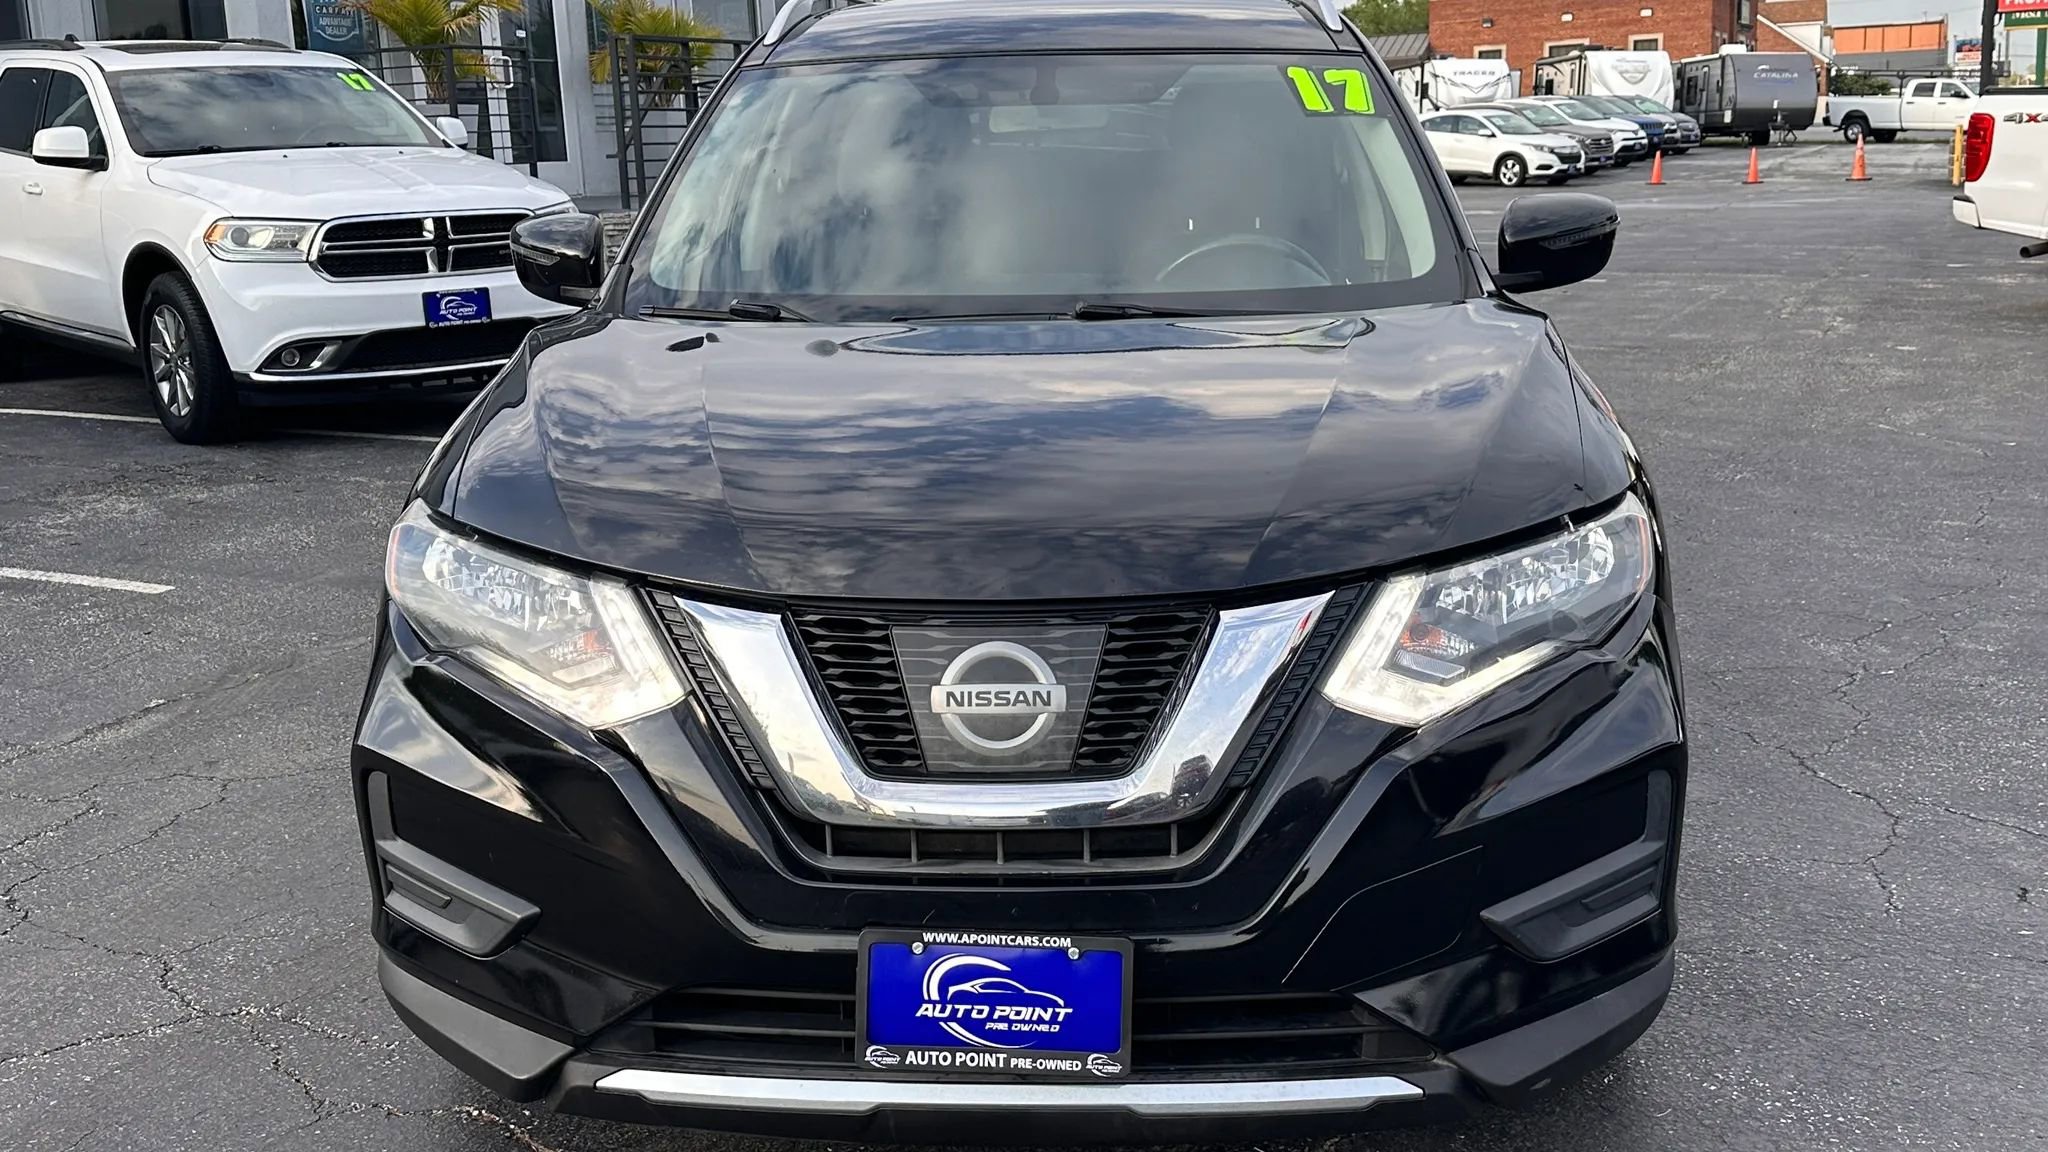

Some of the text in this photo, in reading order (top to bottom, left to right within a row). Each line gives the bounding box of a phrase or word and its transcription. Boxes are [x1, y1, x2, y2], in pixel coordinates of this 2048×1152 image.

[325, 26, 348, 35] DEALER
[336, 72, 376, 92] 17
[1287, 66, 1376, 115] 17
[946, 690, 1052, 707] NISSAN
[922, 932, 1072, 948] WWW.APOINTCARS.COM
[915, 1003, 1074, 1022] AUTO POINT
[985, 1022, 1061, 1033] PRE OWNED
[905, 1050, 1082, 1071] AUTO POINT PRE-OWNED
